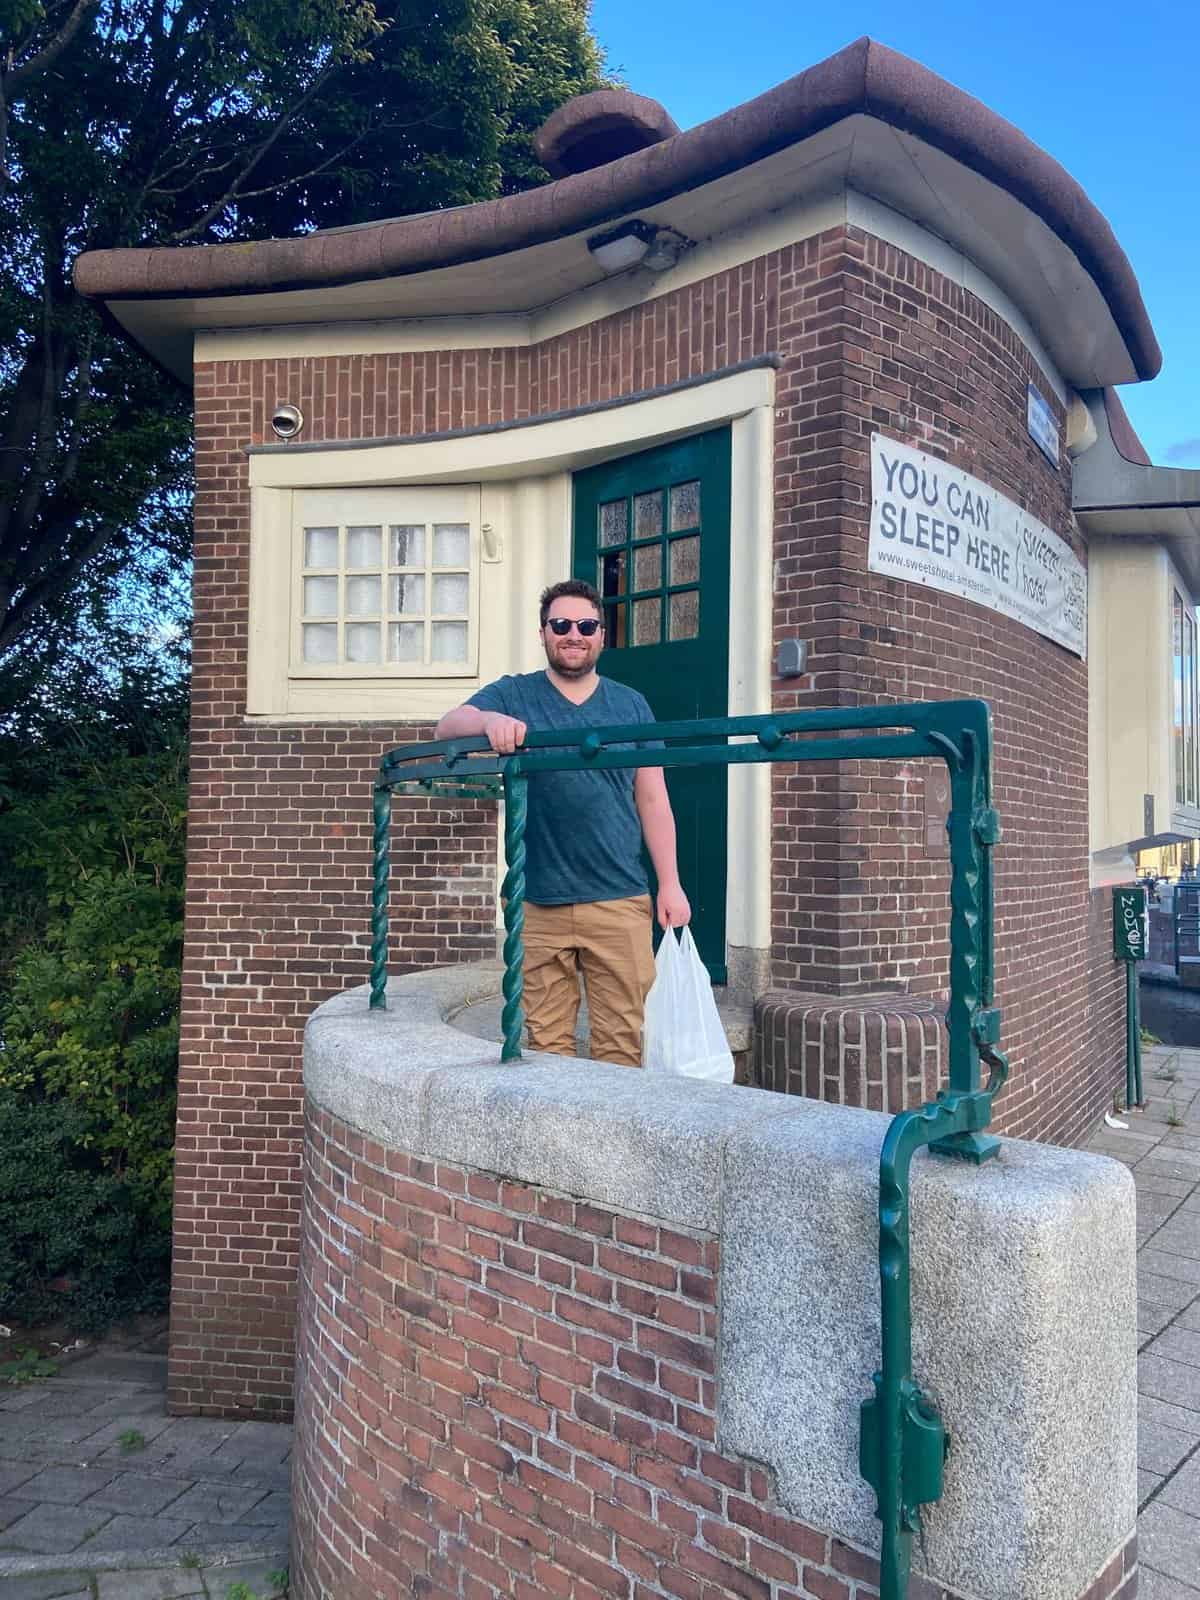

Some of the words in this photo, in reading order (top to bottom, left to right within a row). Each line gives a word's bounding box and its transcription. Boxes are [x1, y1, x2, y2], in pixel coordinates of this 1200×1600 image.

[880, 452, 938, 507] YOU
[947, 482, 990, 532] CAN
[880, 502, 960, 558] SLEEP
[966, 532, 1010, 584] HERE
[1022, 563, 1048, 608] hotel
